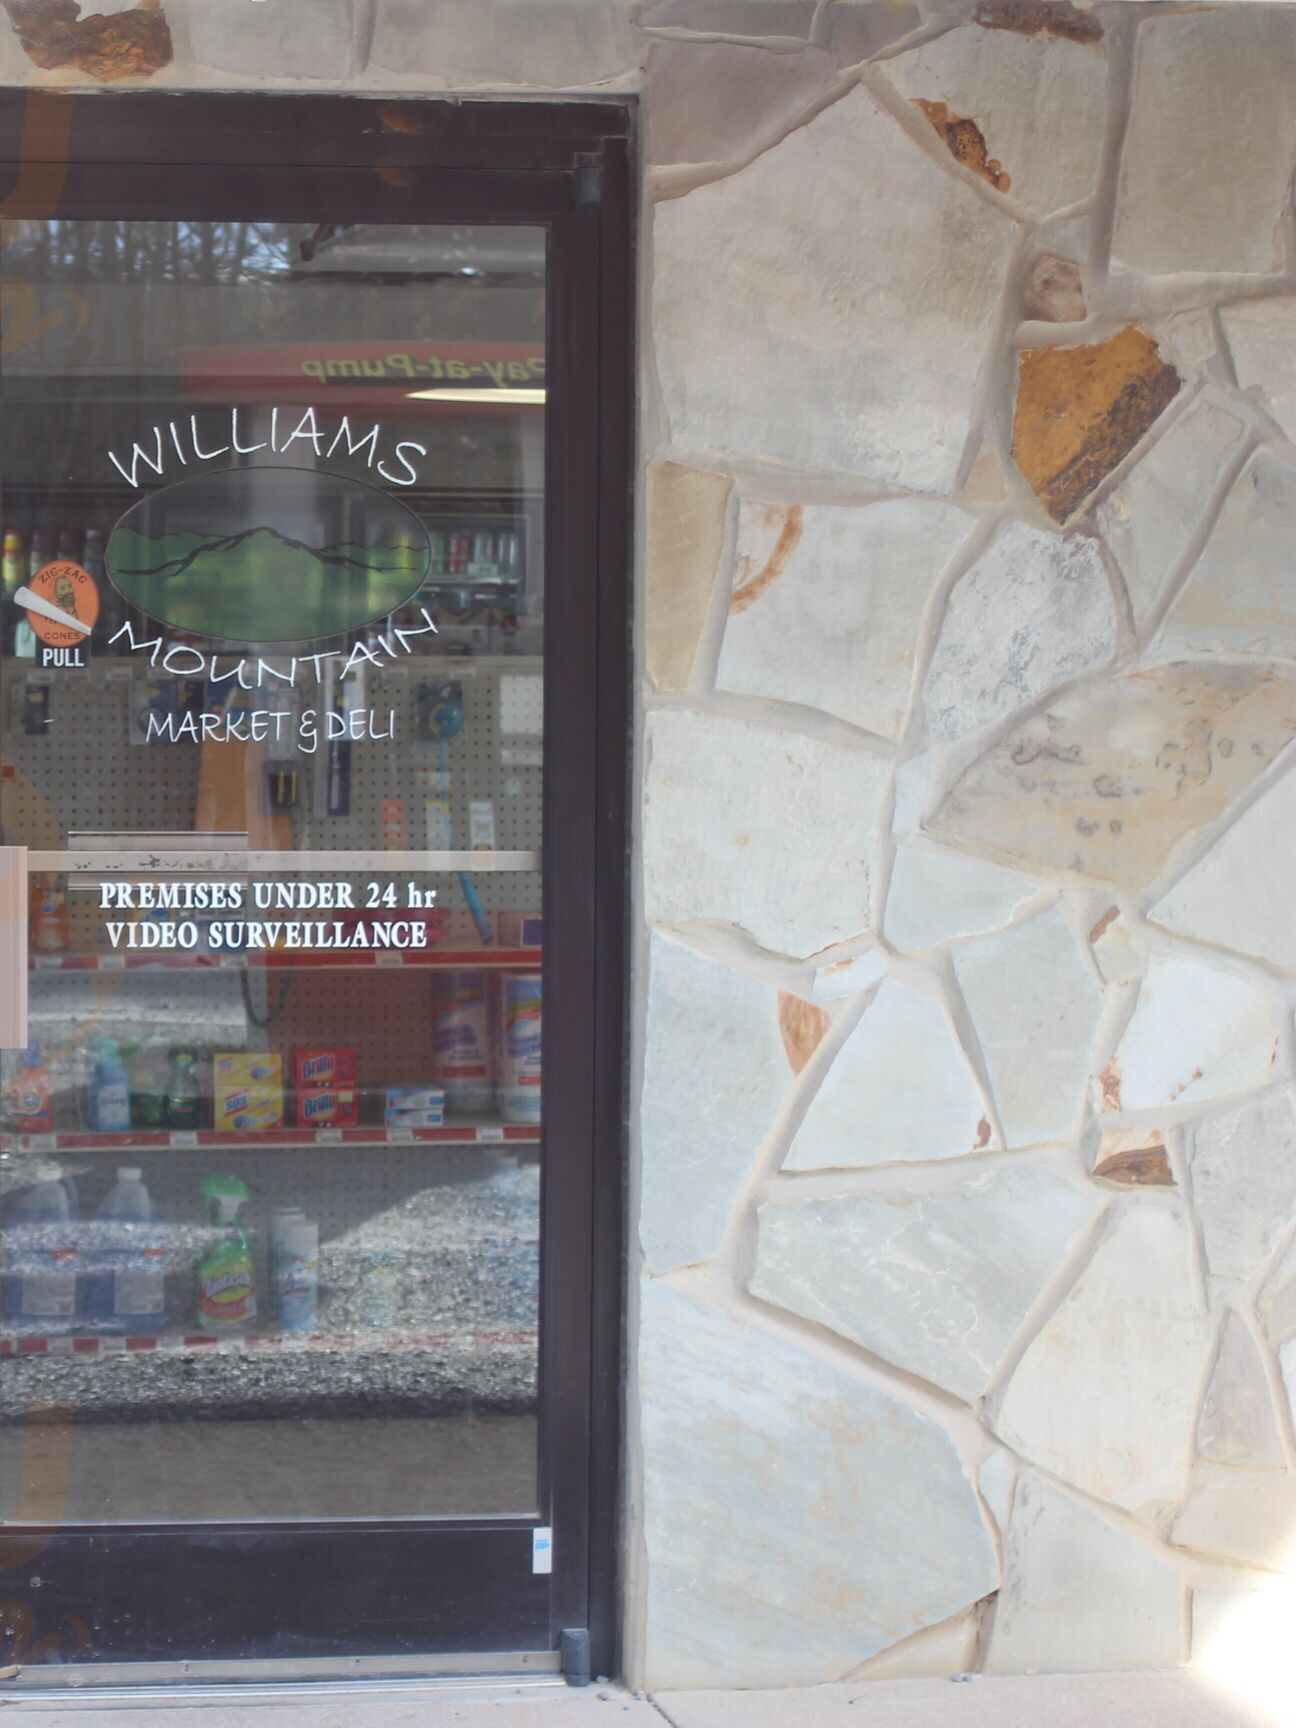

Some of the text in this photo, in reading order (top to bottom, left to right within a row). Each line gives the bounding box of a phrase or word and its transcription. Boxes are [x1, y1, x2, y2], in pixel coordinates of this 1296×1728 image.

[108, 407, 427, 487] WILLIAMS
[39, 566, 87, 584] ZIG-ZAG
[44, 632, 80, 640] CONES
[108, 608, 438, 690] MOUNTAIN
[42, 648, 85, 667] PULL
[146, 710, 292, 743] MARKET
[325, 709, 395, 741] DELI
[99, 881, 437, 908] PREMISES UNDER 24 hr
[105, 921, 428, 948] VIDEO SURVEILLANCE
